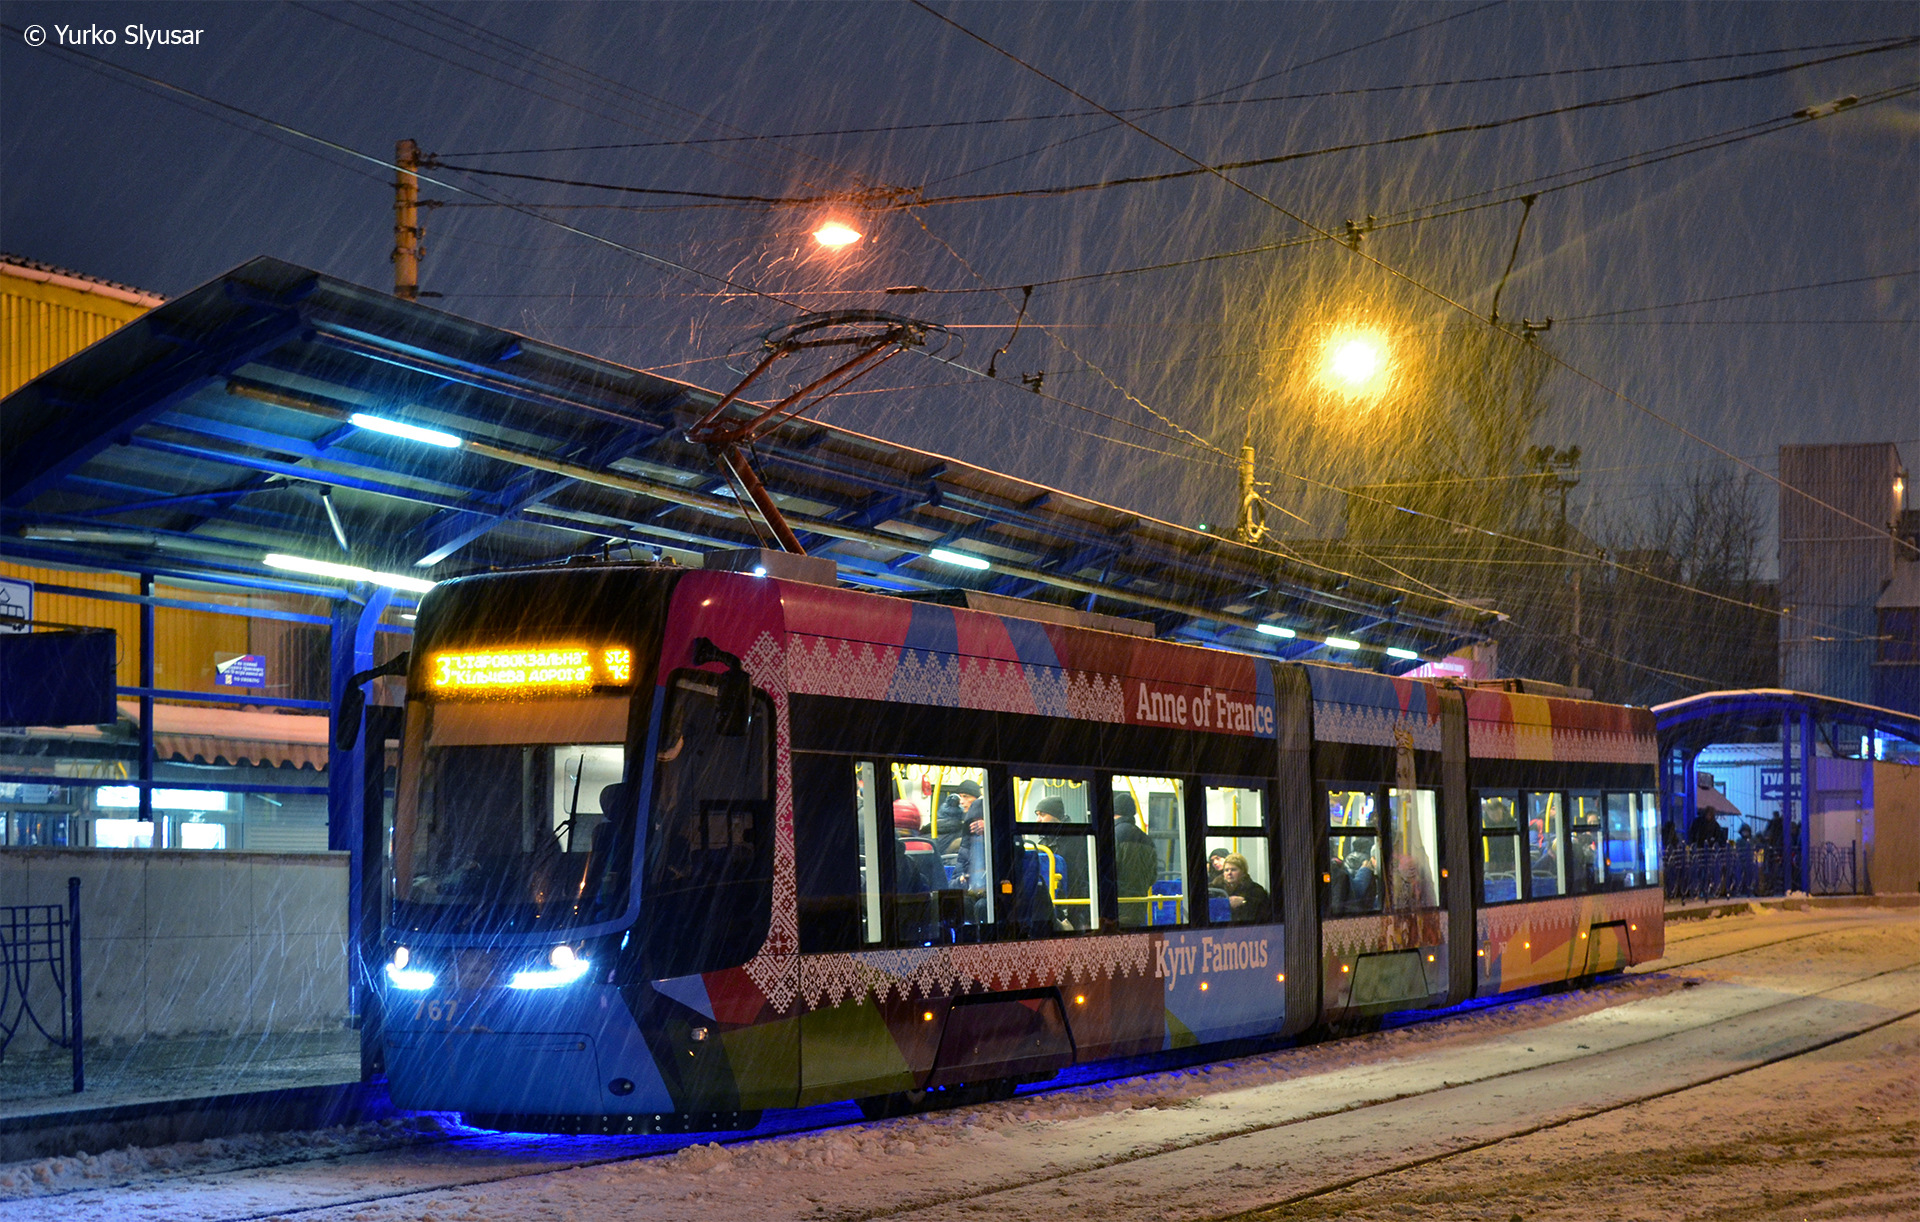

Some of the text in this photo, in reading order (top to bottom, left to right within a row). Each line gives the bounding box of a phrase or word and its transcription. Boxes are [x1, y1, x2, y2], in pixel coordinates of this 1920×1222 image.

[436, 656, 451, 686] 3
[1136, 682, 1274, 735] Anne of France
[1155, 934, 1269, 992] Kyiv Famous
[413, 999, 458, 1022] 767
